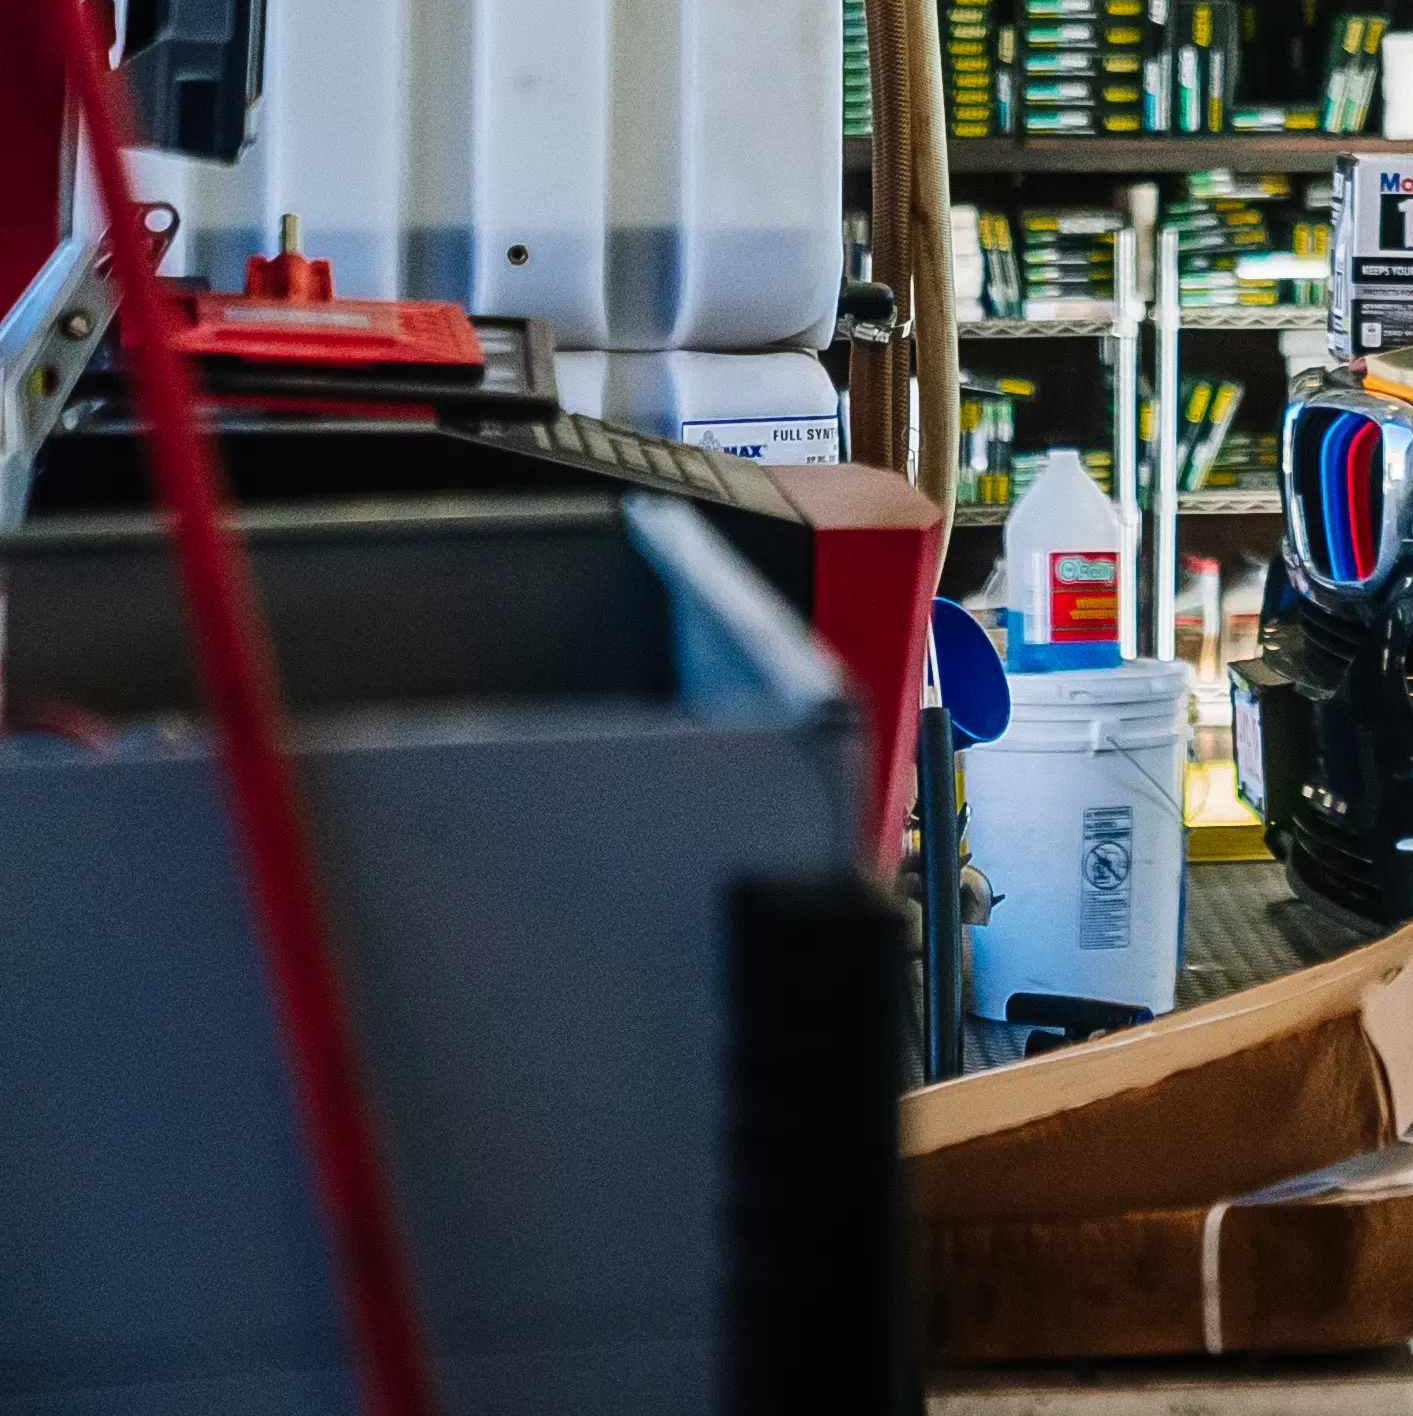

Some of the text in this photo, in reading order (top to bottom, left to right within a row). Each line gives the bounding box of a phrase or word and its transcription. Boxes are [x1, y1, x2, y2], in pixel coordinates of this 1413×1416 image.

[1361, 265, 1390, 276] KEEPS
[772, 427, 838, 442] FULL SYNT
